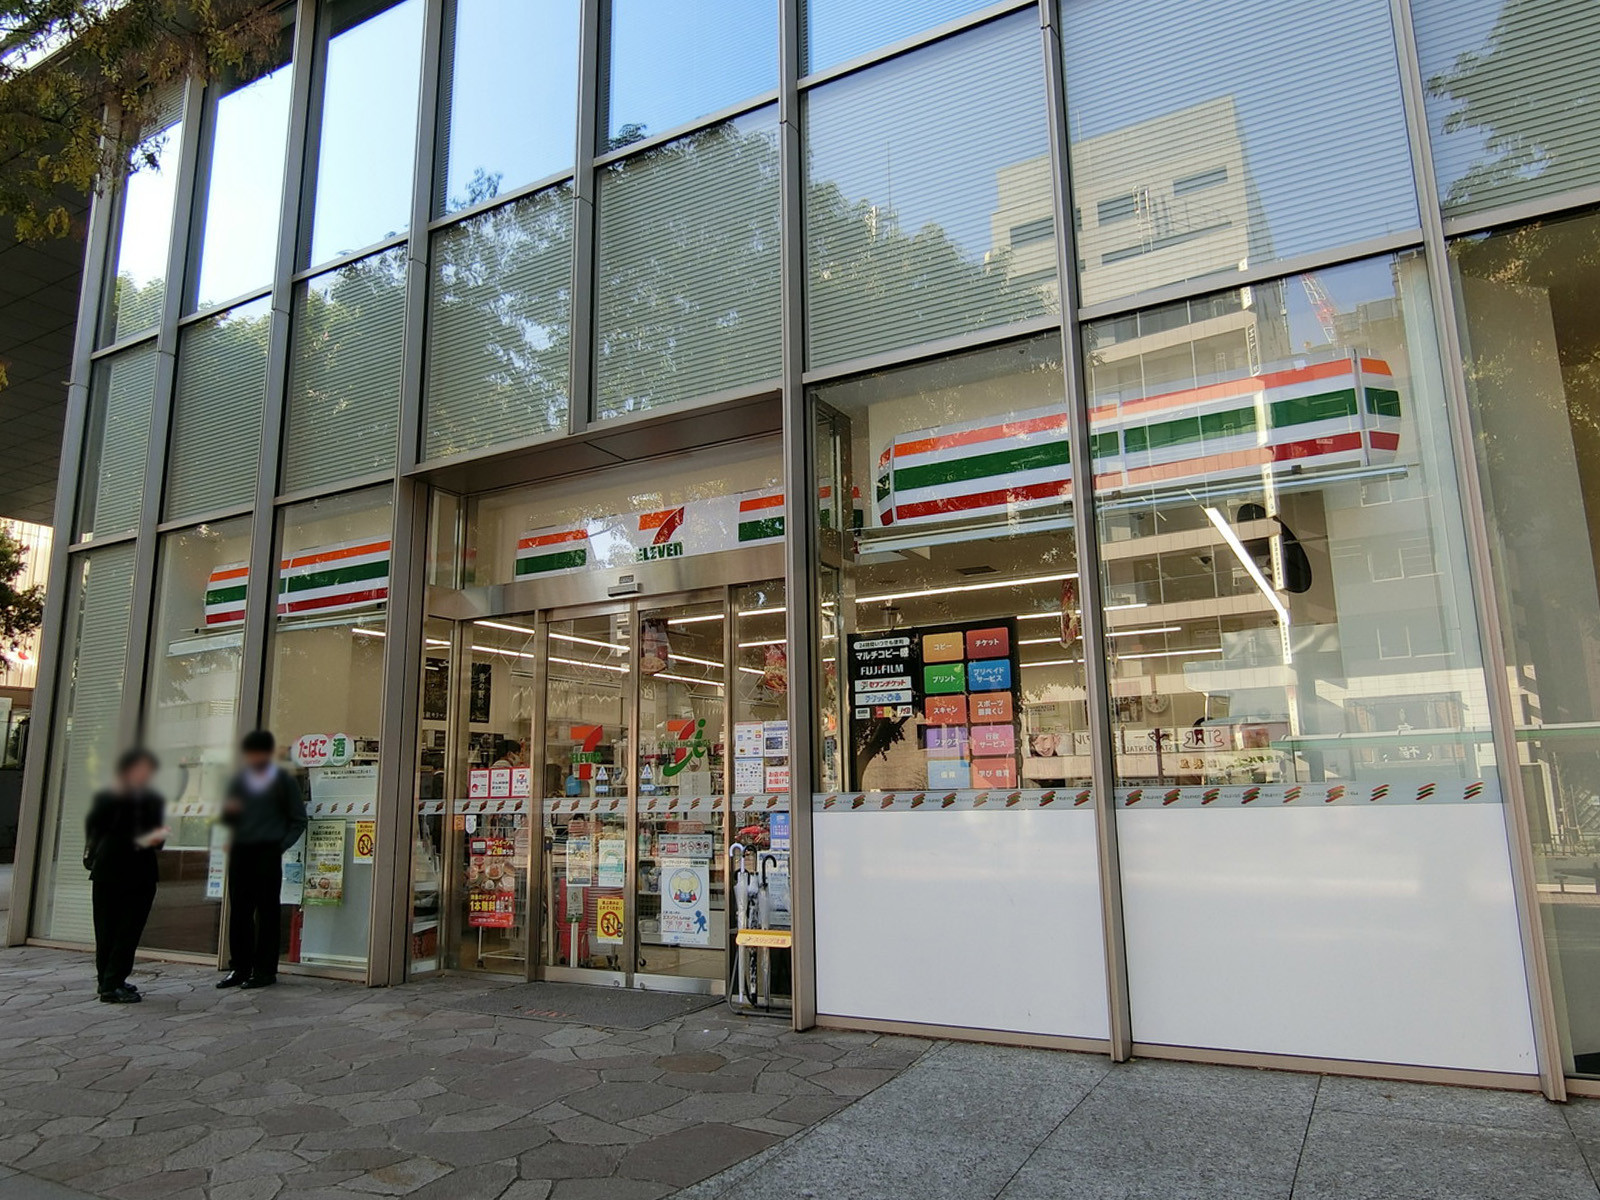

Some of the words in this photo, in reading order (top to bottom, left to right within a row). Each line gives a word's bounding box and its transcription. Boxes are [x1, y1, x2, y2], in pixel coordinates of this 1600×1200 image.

[974, 639, 999, 647] チケット
[860, 664, 904, 676] FUJIFILM
[932, 675, 956, 684] プリント
[976, 675, 1003, 684] サービス
[933, 706, 958, 715] スキャン
[298, 739, 327, 758] たばこ
[332, 738, 346, 757] 酒
[470, 901, 495, 912] 1本無料
